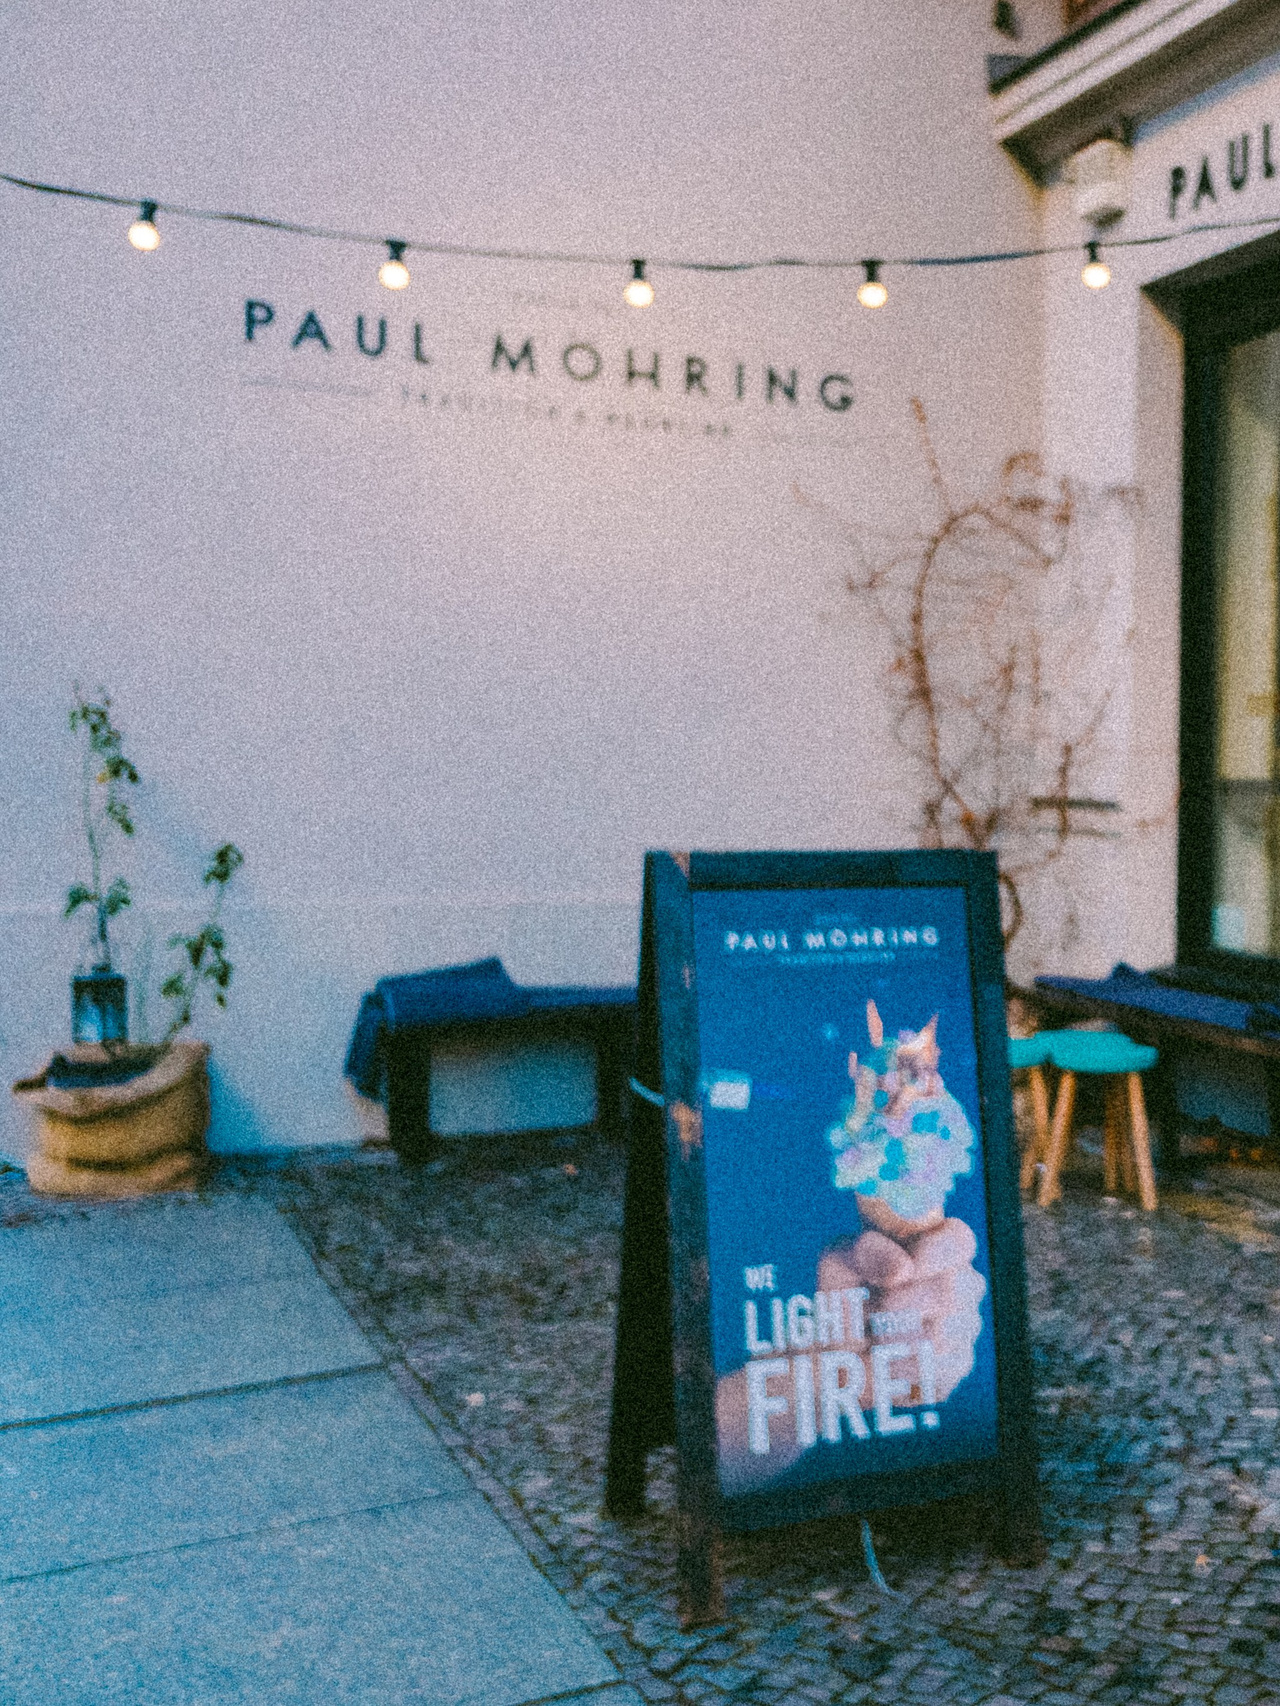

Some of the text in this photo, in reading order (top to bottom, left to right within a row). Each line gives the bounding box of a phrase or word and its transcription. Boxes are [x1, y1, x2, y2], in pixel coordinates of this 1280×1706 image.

[1168, 122, 1276, 219] PAUL
[243, 297, 432, 366] PAUL
[725, 929, 790, 952] PAUL
[743, 1263, 776, 1293] WE
[743, 1286, 871, 1356] LIGHT
[744, 1339, 941, 1456] FIRE!
